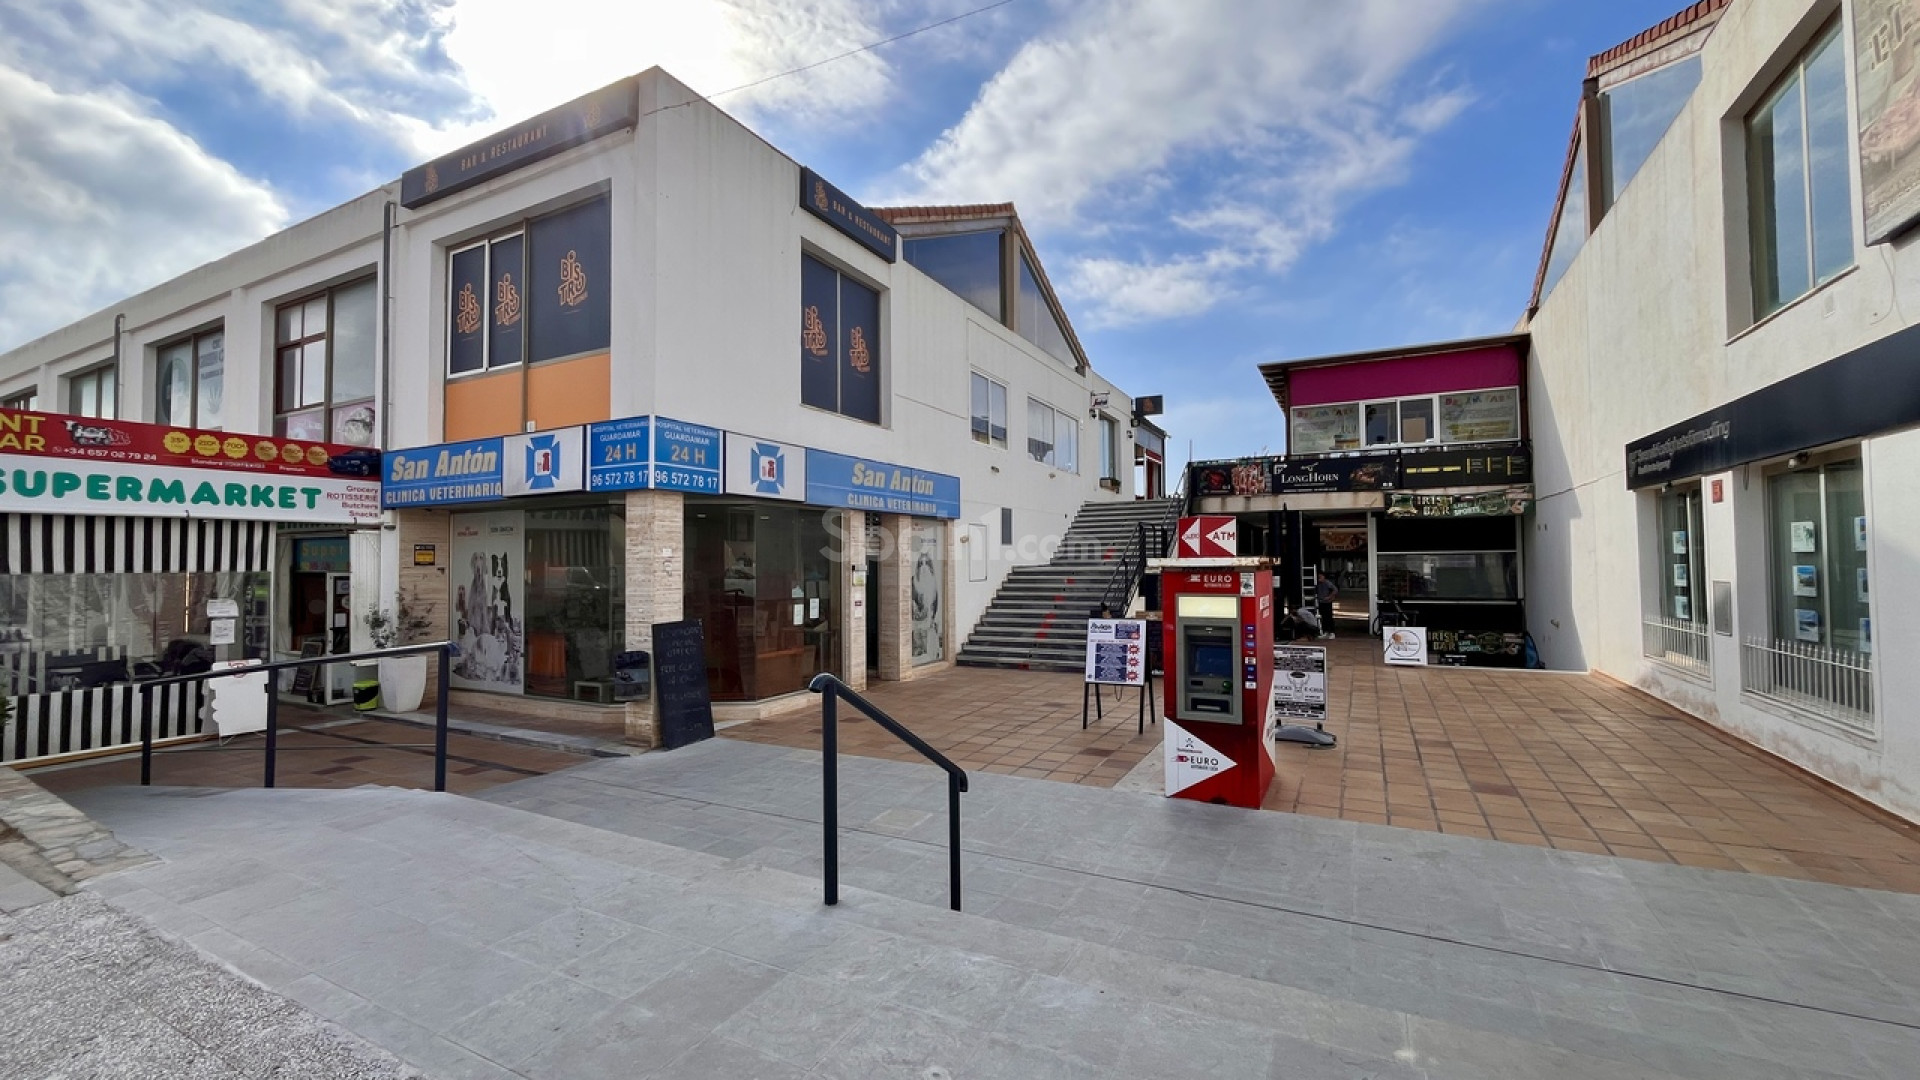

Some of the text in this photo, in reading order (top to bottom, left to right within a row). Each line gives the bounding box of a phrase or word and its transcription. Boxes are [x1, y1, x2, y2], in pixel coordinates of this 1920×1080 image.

[461, 153, 477, 171] BAR
[491, 124, 548, 160] RESTAURANT
[833, 200, 846, 217] BAR
[855, 215, 892, 246] RESTAURANT
[616, 420, 649, 430] VETERINARIO
[655, 420, 682, 431] HOSPITAL
[599, 430, 641, 441] GUARDAMAR
[664, 430, 711, 445] GUARDAMAR
[63, 448, 85, 456] +34
[87, 449, 108, 457] 657
[110, 451, 126, 459] 02
[128, 452, 142, 460] 79
[605, 441, 637, 463] 24 H
[671, 443, 706, 465] 24 H
[391, 446, 498, 481] San Antón
[592, 469, 649, 487] 96 572 78 17
[654, 470, 718, 489] 96 572 78 17
[851, 462, 934, 496] San Antón
[0, 467, 322, 510] UPERMARKET
[346, 485, 379, 495] Grocery
[386, 482, 502, 504] CLINICA VETERINARIA
[326, 492, 379, 502] ROTISSERIE
[847, 492, 937, 514] CLINICA VETERINARIA
[341, 502, 379, 510] Butchers
[348, 509, 379, 518] Snacks
[1212, 531, 1236, 541] ATM
[1203, 574, 1233, 583] EURO
[1190, 755, 1219, 766] EURO
